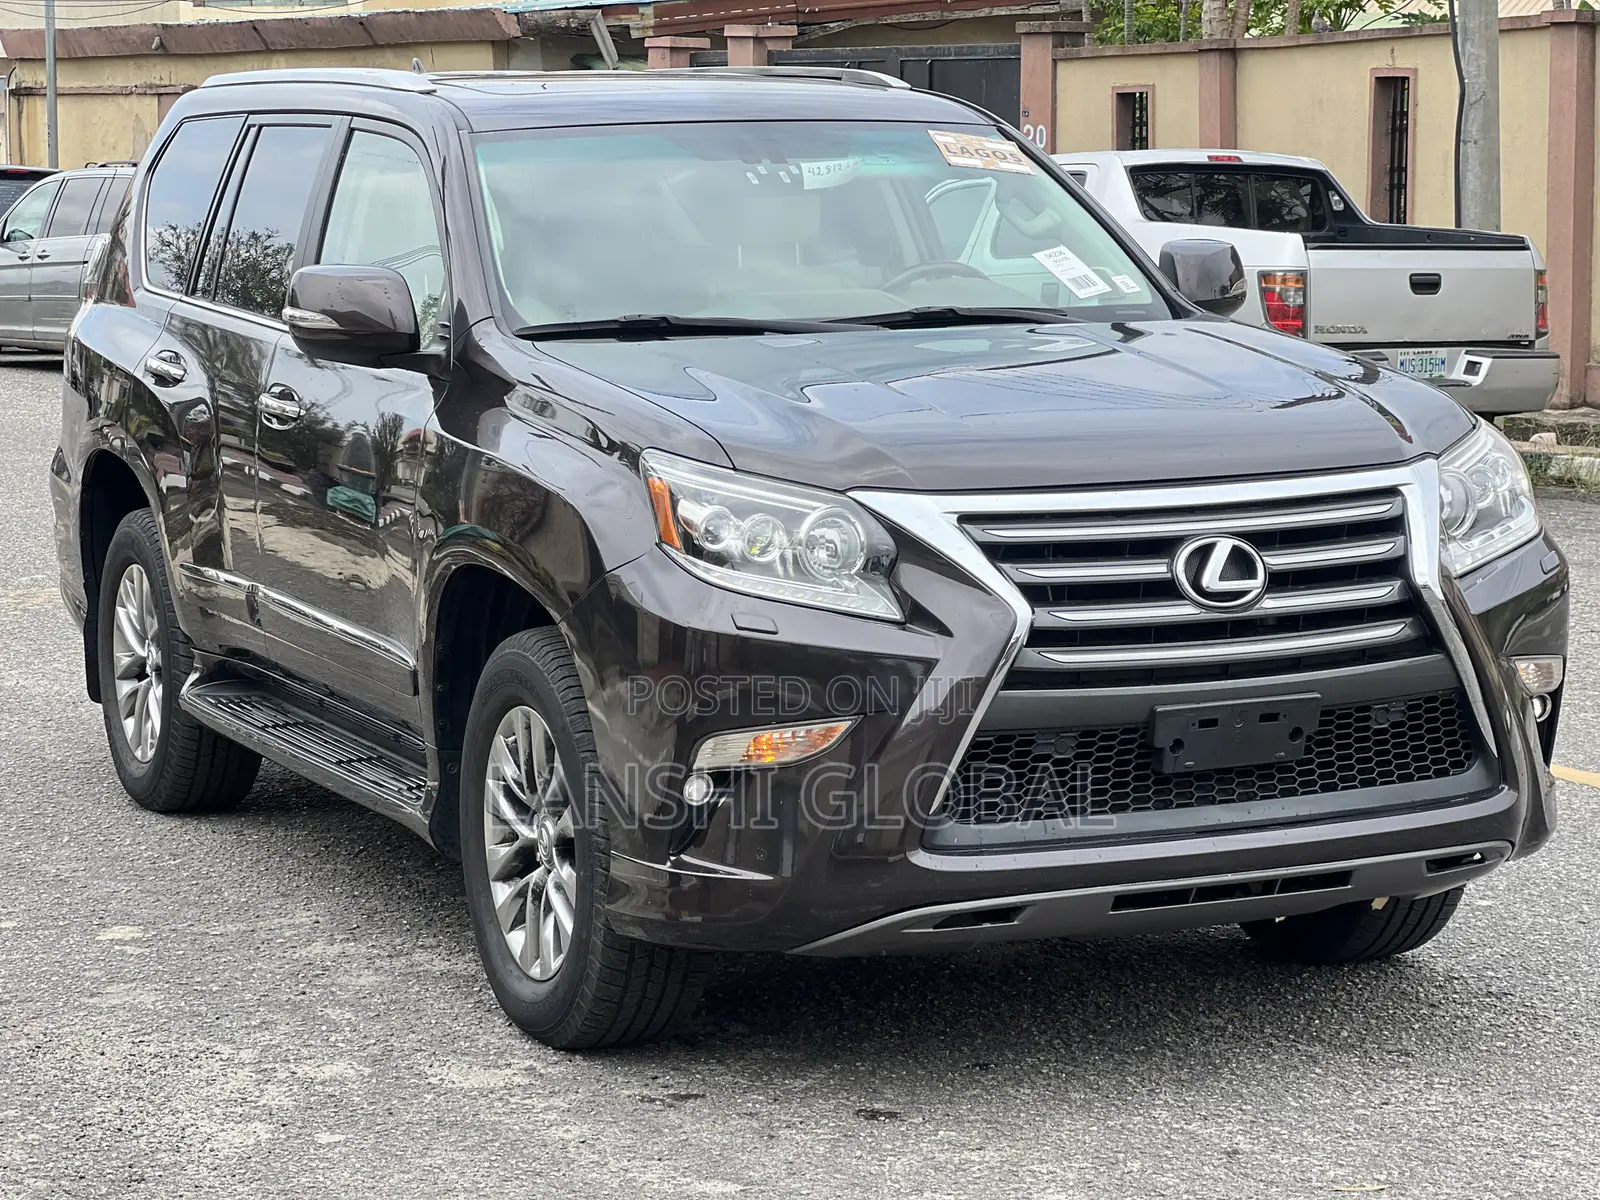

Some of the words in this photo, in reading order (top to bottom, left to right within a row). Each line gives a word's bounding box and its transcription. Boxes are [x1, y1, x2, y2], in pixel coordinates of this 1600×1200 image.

[1023, 124, 1046, 149] 20
[943, 143, 1023, 163] LAGOS
[1313, 325, 1368, 334] HONDA
